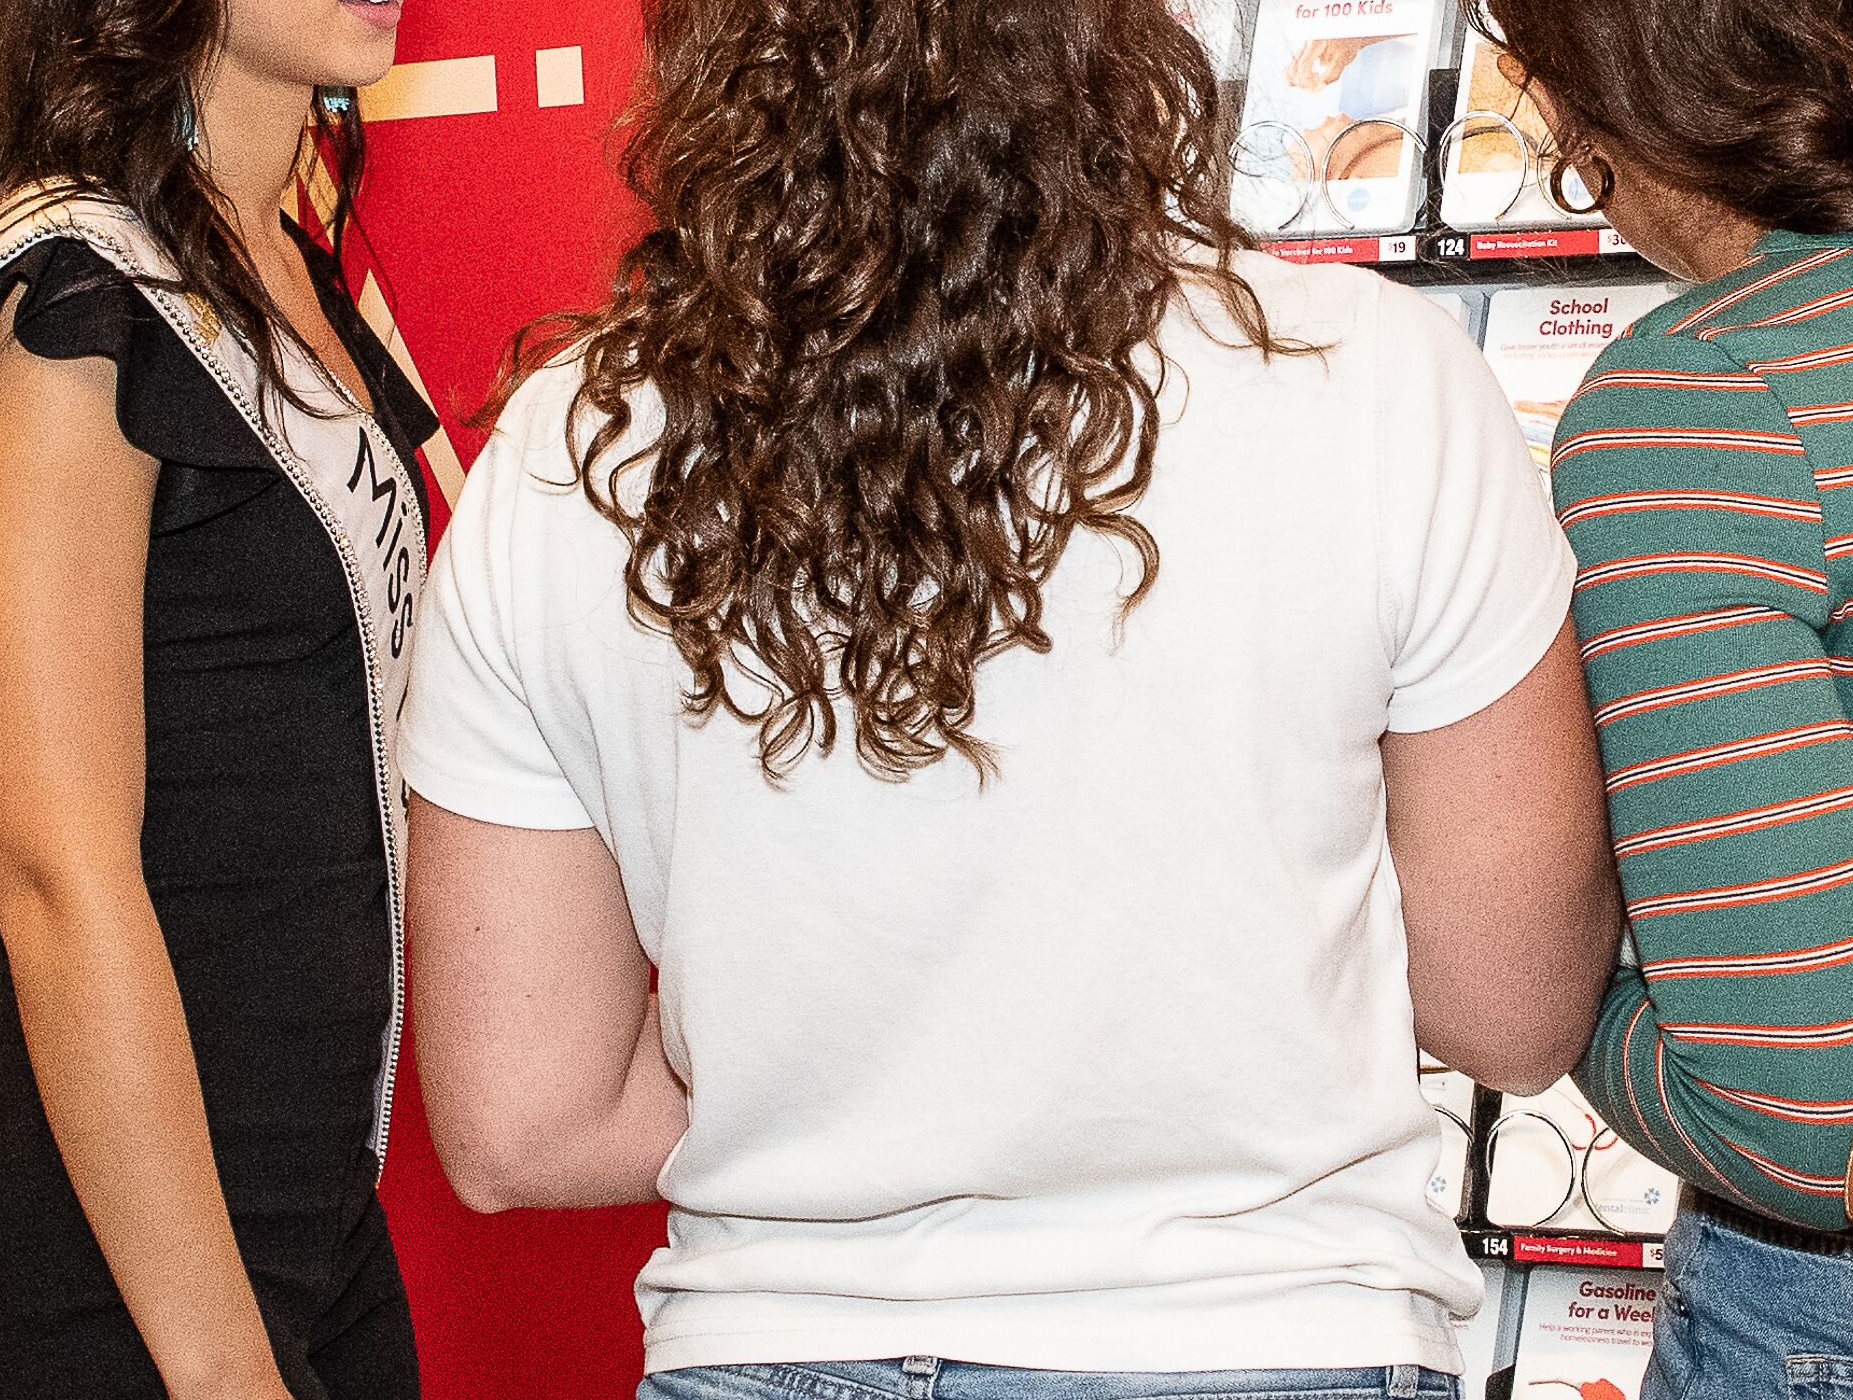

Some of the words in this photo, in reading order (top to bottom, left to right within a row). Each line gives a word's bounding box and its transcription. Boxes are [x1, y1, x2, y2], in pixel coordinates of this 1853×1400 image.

[1295, 4, 1319, 19] for
[1324, 3, 1352, 17] 100
[1357, 0, 1393, 16] Kids
[1437, 238, 1465, 256] 124
[1549, 297, 1609, 315] School
[1539, 319, 1613, 339] Clothing
[1482, 1237, 1509, 1256] 154
[1579, 1280, 1657, 1302] Gasoline
[1568, 1302, 1595, 1319] for
[1597, 1308, 1610, 1320] a
[1614, 1304, 1655, 1323] Wee
